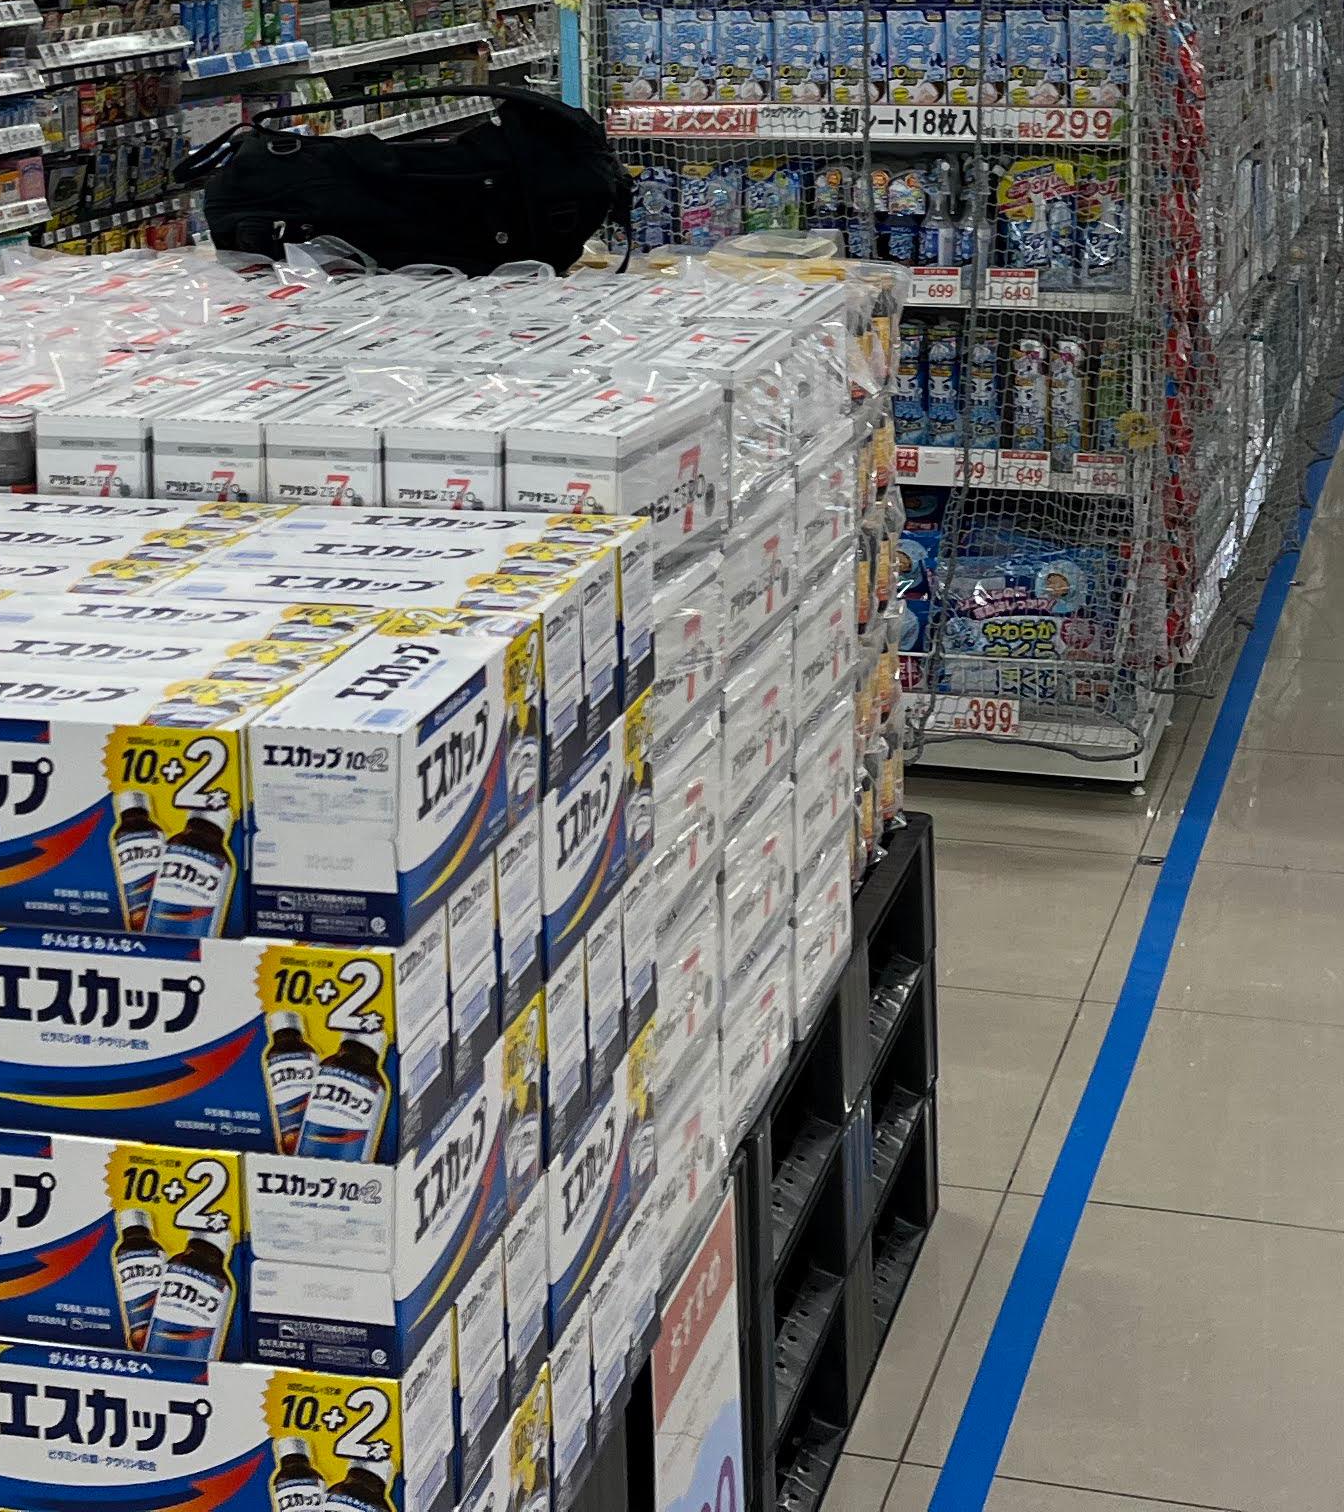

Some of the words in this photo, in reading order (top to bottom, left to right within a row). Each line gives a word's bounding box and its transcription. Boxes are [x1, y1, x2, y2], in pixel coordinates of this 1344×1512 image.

[1044, 109, 1114, 139] 299
[928, 284, 954, 298] 699
[1004, 285, 1032, 300] 649
[1015, 468, 1044, 484] 649
[984, 620, 1056, 641] やわらか
[334, 641, 441, 701] エスカップ
[968, 699, 1013, 733] 399
[262, 745, 344, 770] エスカップ
[416, 700, 491, 823] エスカップ
[257, 1171, 336, 1199] エスカップ
